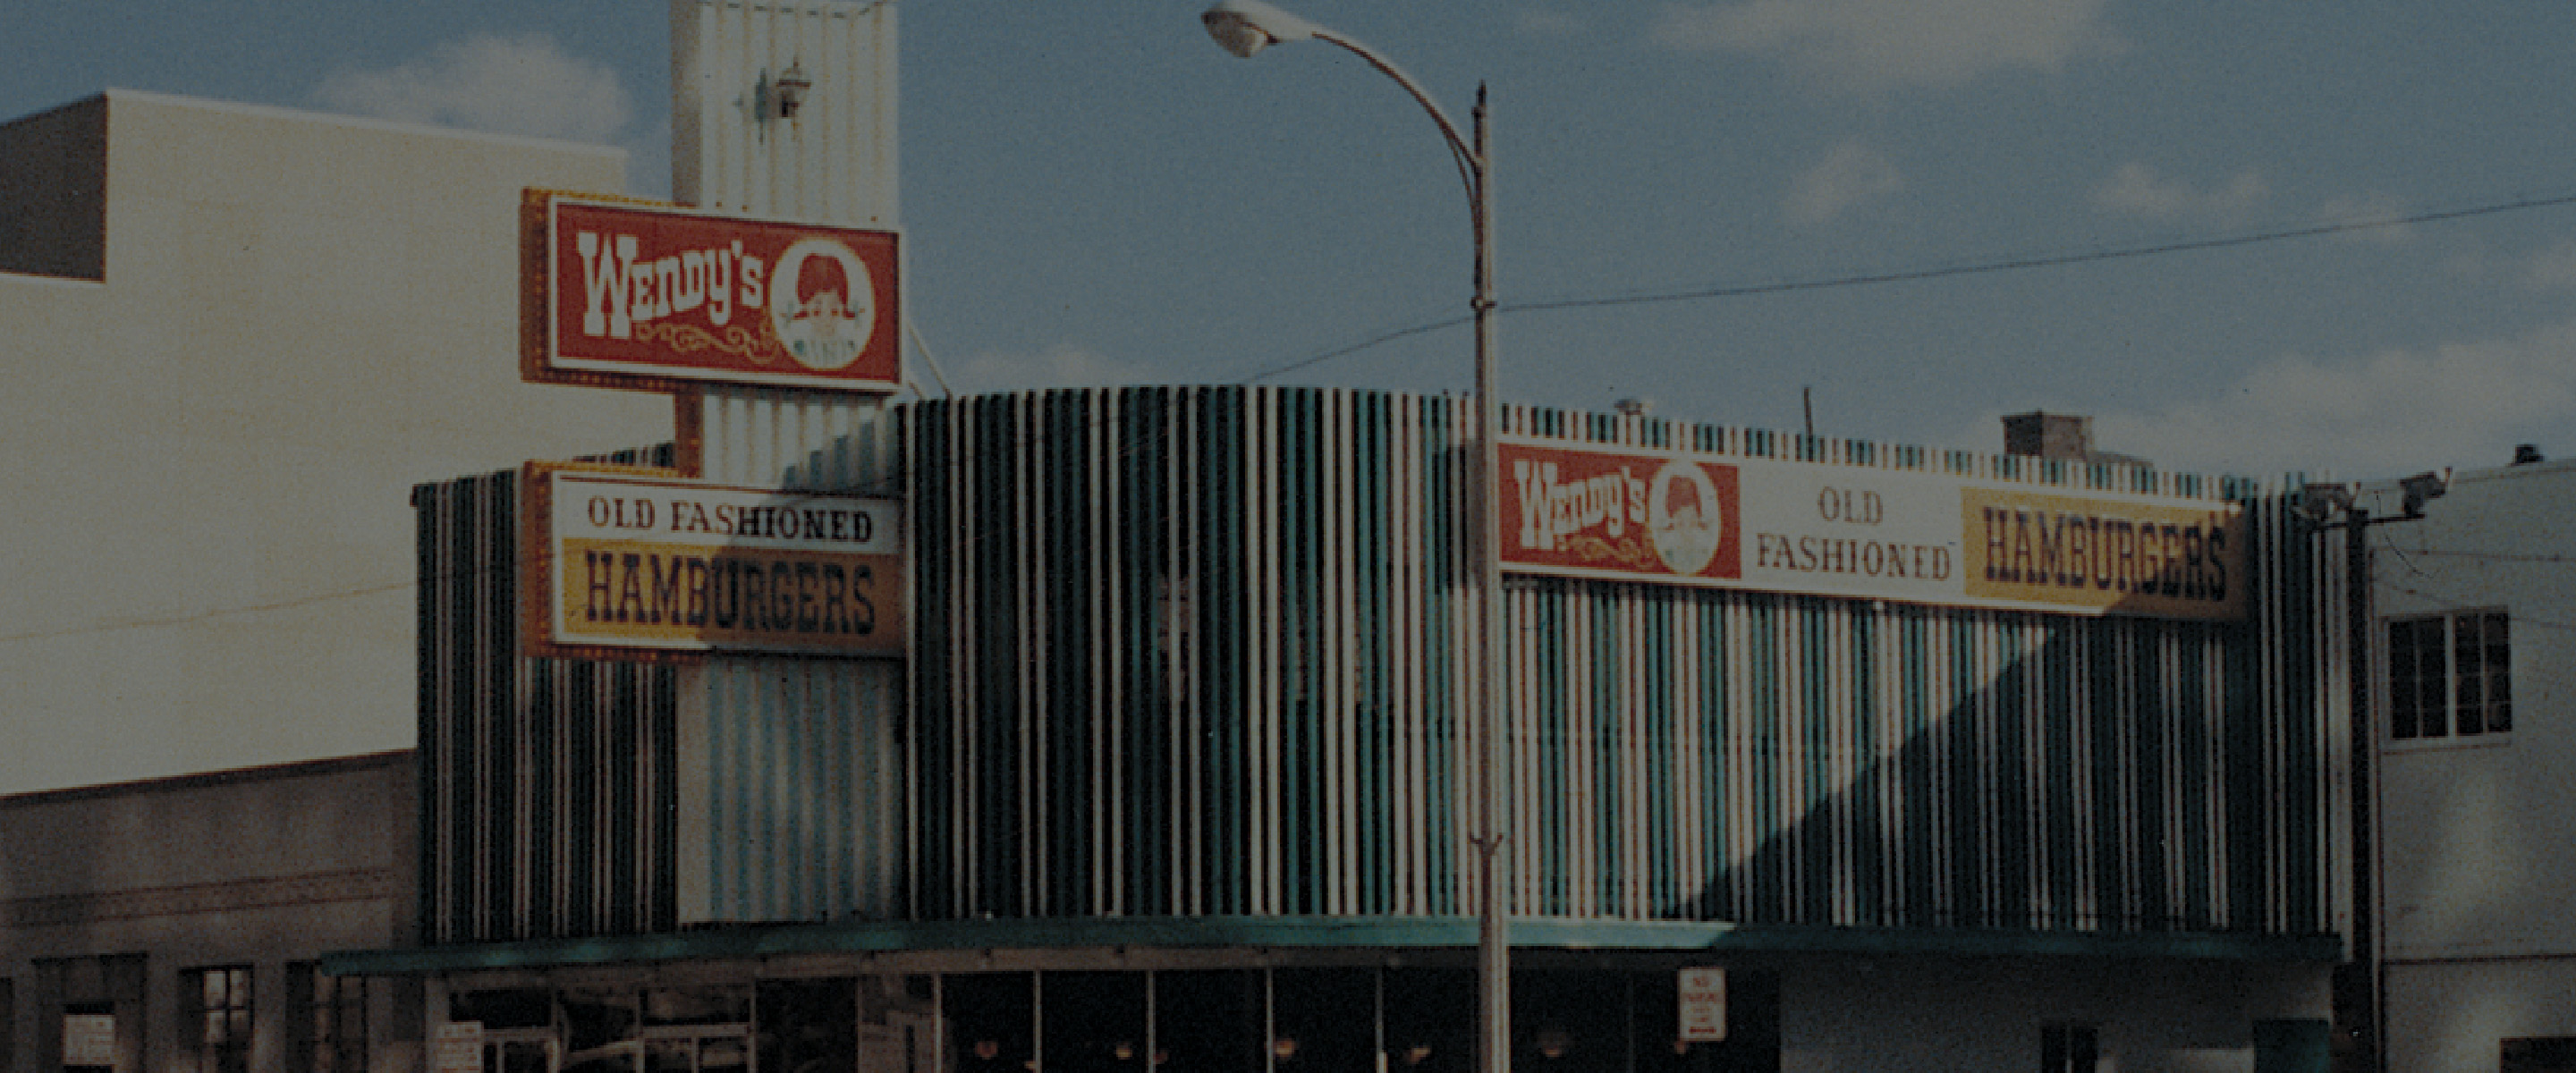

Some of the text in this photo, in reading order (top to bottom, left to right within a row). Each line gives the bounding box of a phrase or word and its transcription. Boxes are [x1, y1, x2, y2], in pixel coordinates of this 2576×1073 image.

[587, 495, 873, 543] OLD FASHIONED
[1817, 486, 1884, 526] OLD
[1756, 534, 1952, 581] FASHIONED
[1982, 506, 2227, 602] HAMBURGERS
[585, 549, 876, 636] HAMBURGERS
